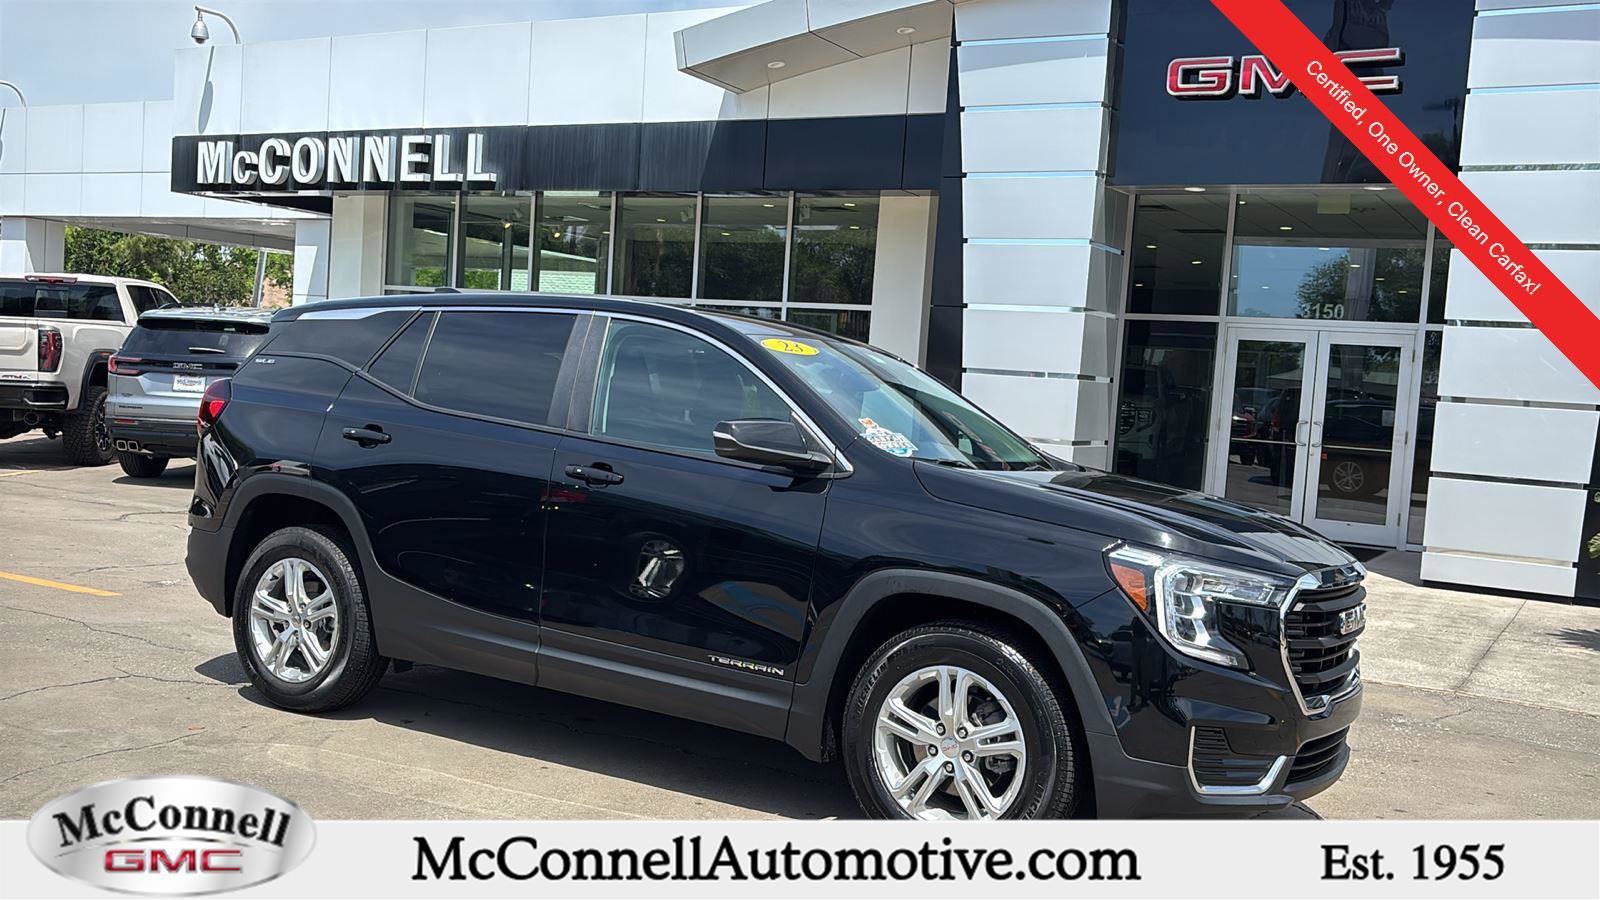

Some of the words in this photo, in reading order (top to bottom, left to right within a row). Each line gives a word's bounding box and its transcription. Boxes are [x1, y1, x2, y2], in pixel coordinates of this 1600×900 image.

[1300, 302, 1345, 319] 3150
[777, 341, 804, 352] 23
[172, 362, 203, 370] GMC
[707, 654, 785, 676] TERRAIN
